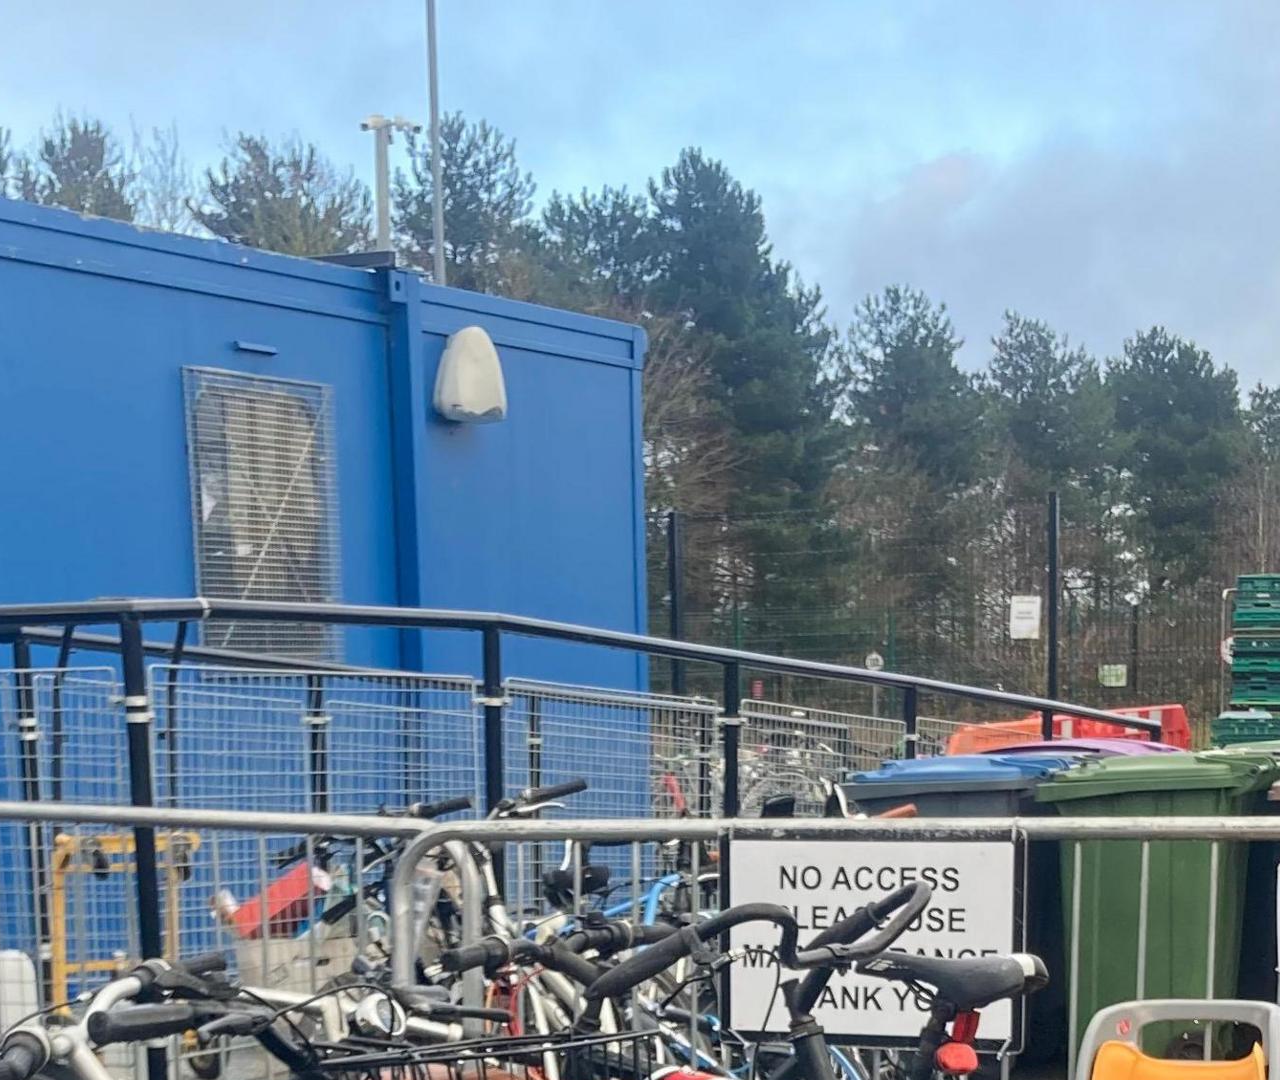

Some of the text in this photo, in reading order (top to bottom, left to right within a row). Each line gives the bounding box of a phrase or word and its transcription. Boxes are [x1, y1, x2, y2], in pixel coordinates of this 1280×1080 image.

[780, 866, 960, 891] NO ACCESS
[817, 986, 933, 1011] ANK YO
